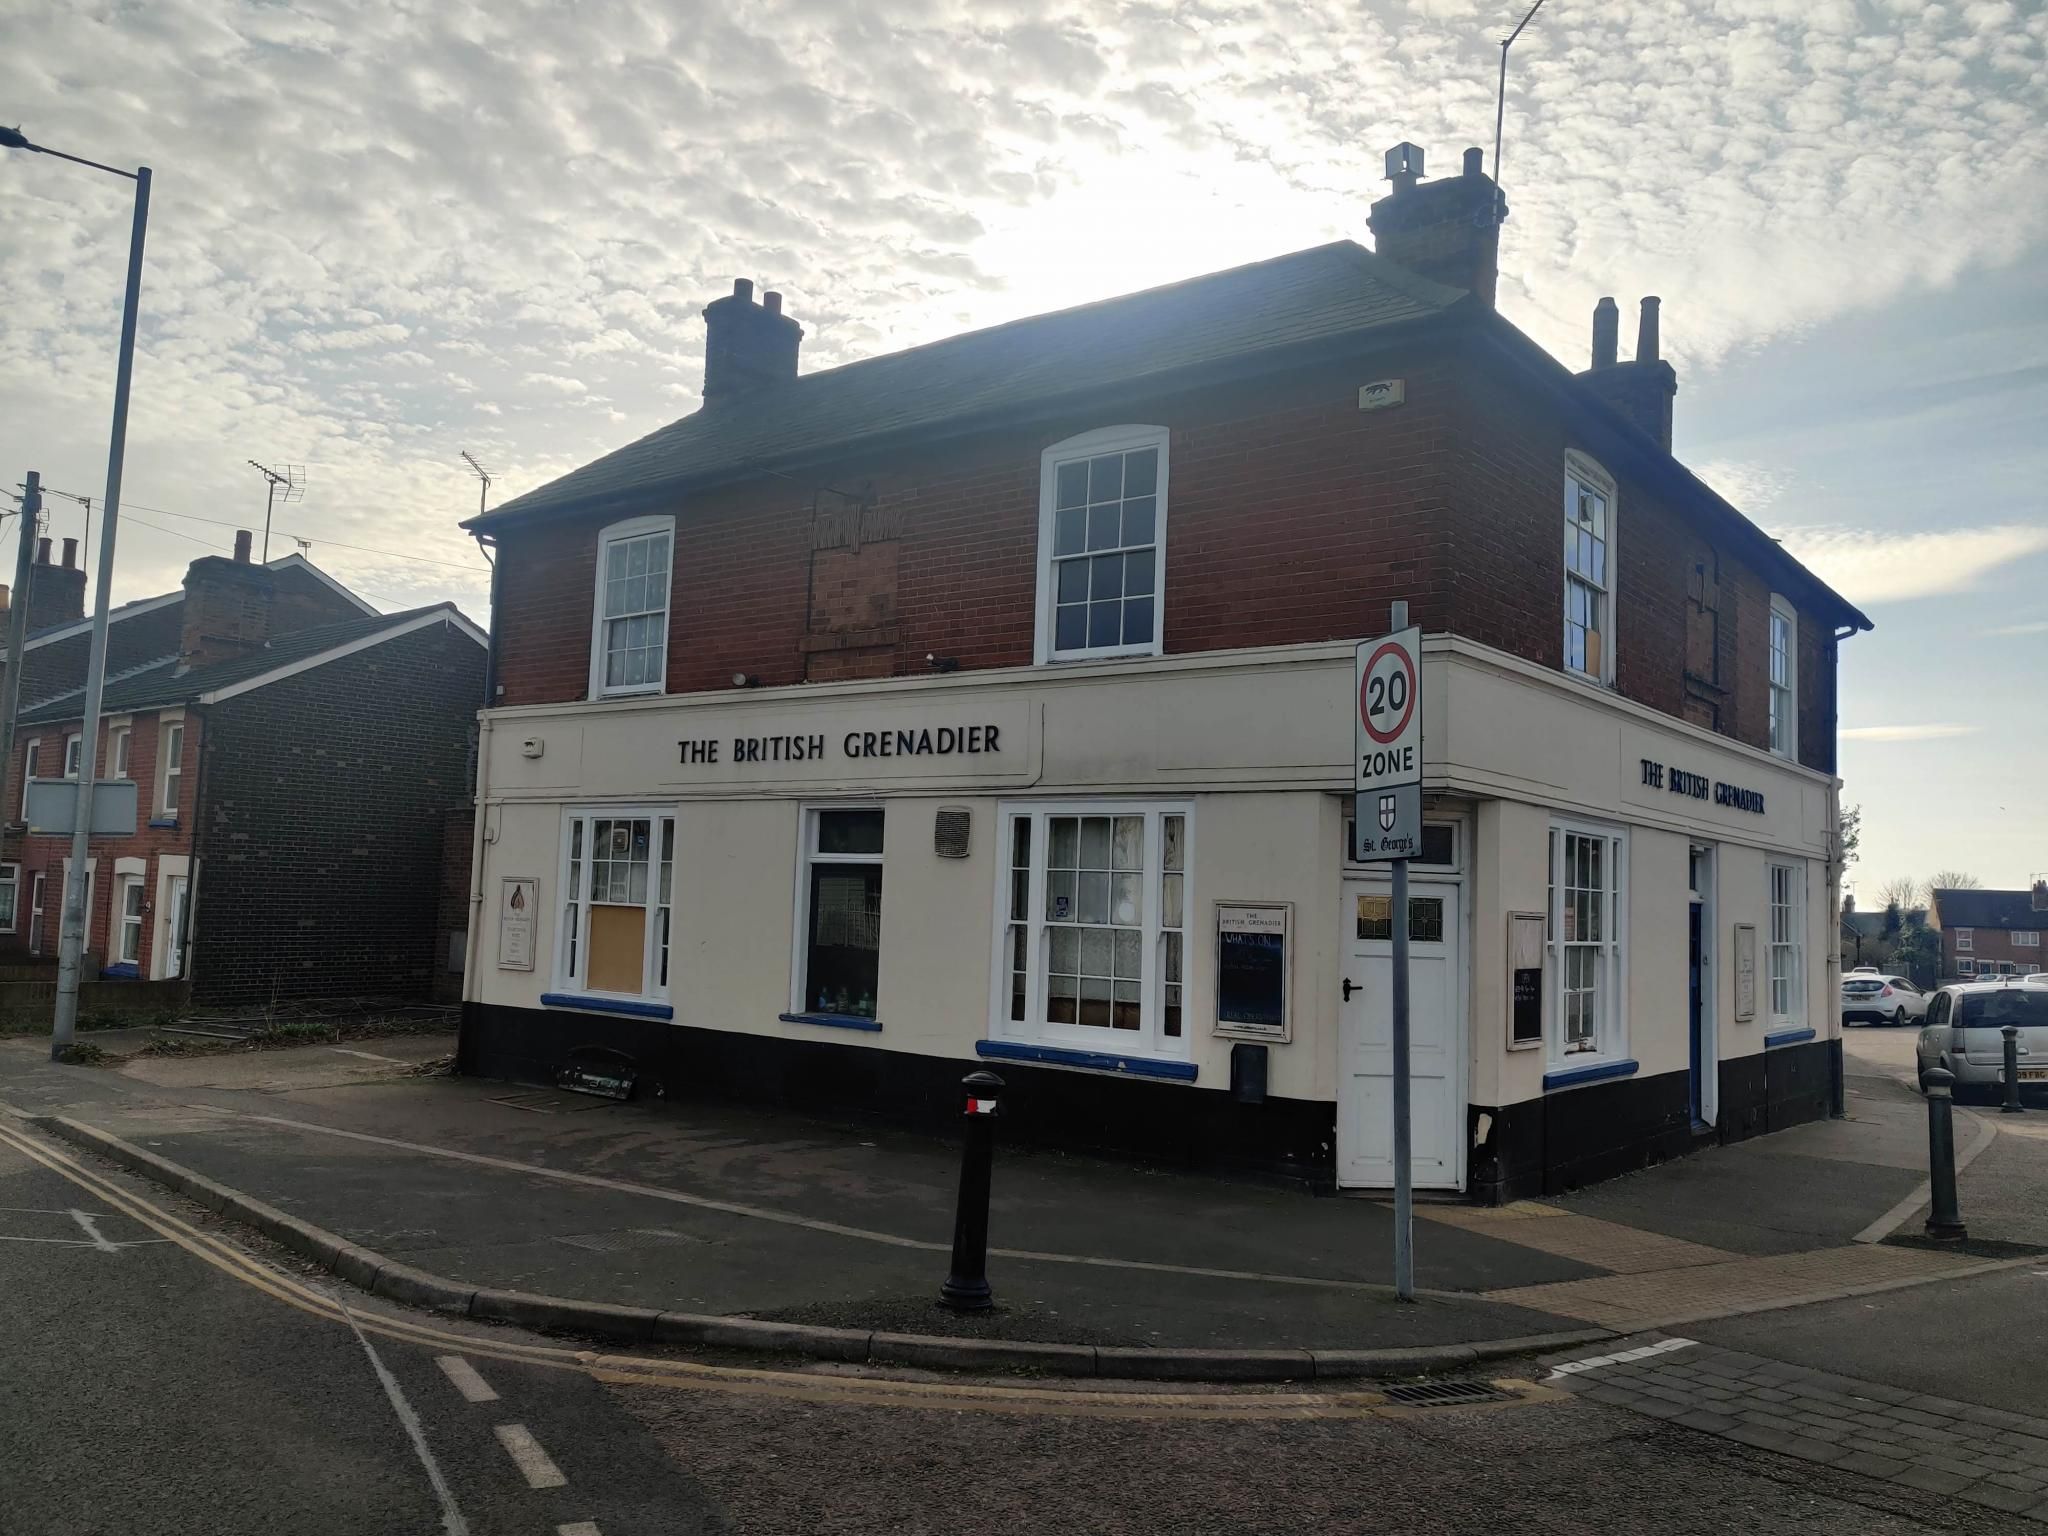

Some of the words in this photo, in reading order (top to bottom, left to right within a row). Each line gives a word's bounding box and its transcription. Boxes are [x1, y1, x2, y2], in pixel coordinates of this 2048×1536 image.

[1369, 670, 1407, 716] 20
[678, 740, 719, 764] THE
[733, 735, 825, 763] BRITISH
[843, 725, 1001, 759] GRENADIER
[1362, 746, 1414, 778] ZONE
[1640, 759, 1664, 788] THE
[1669, 767, 1709, 800] BRITISH
[1714, 782, 1765, 814] GRENADIER
[1381, 832, 1414, 852] George's
